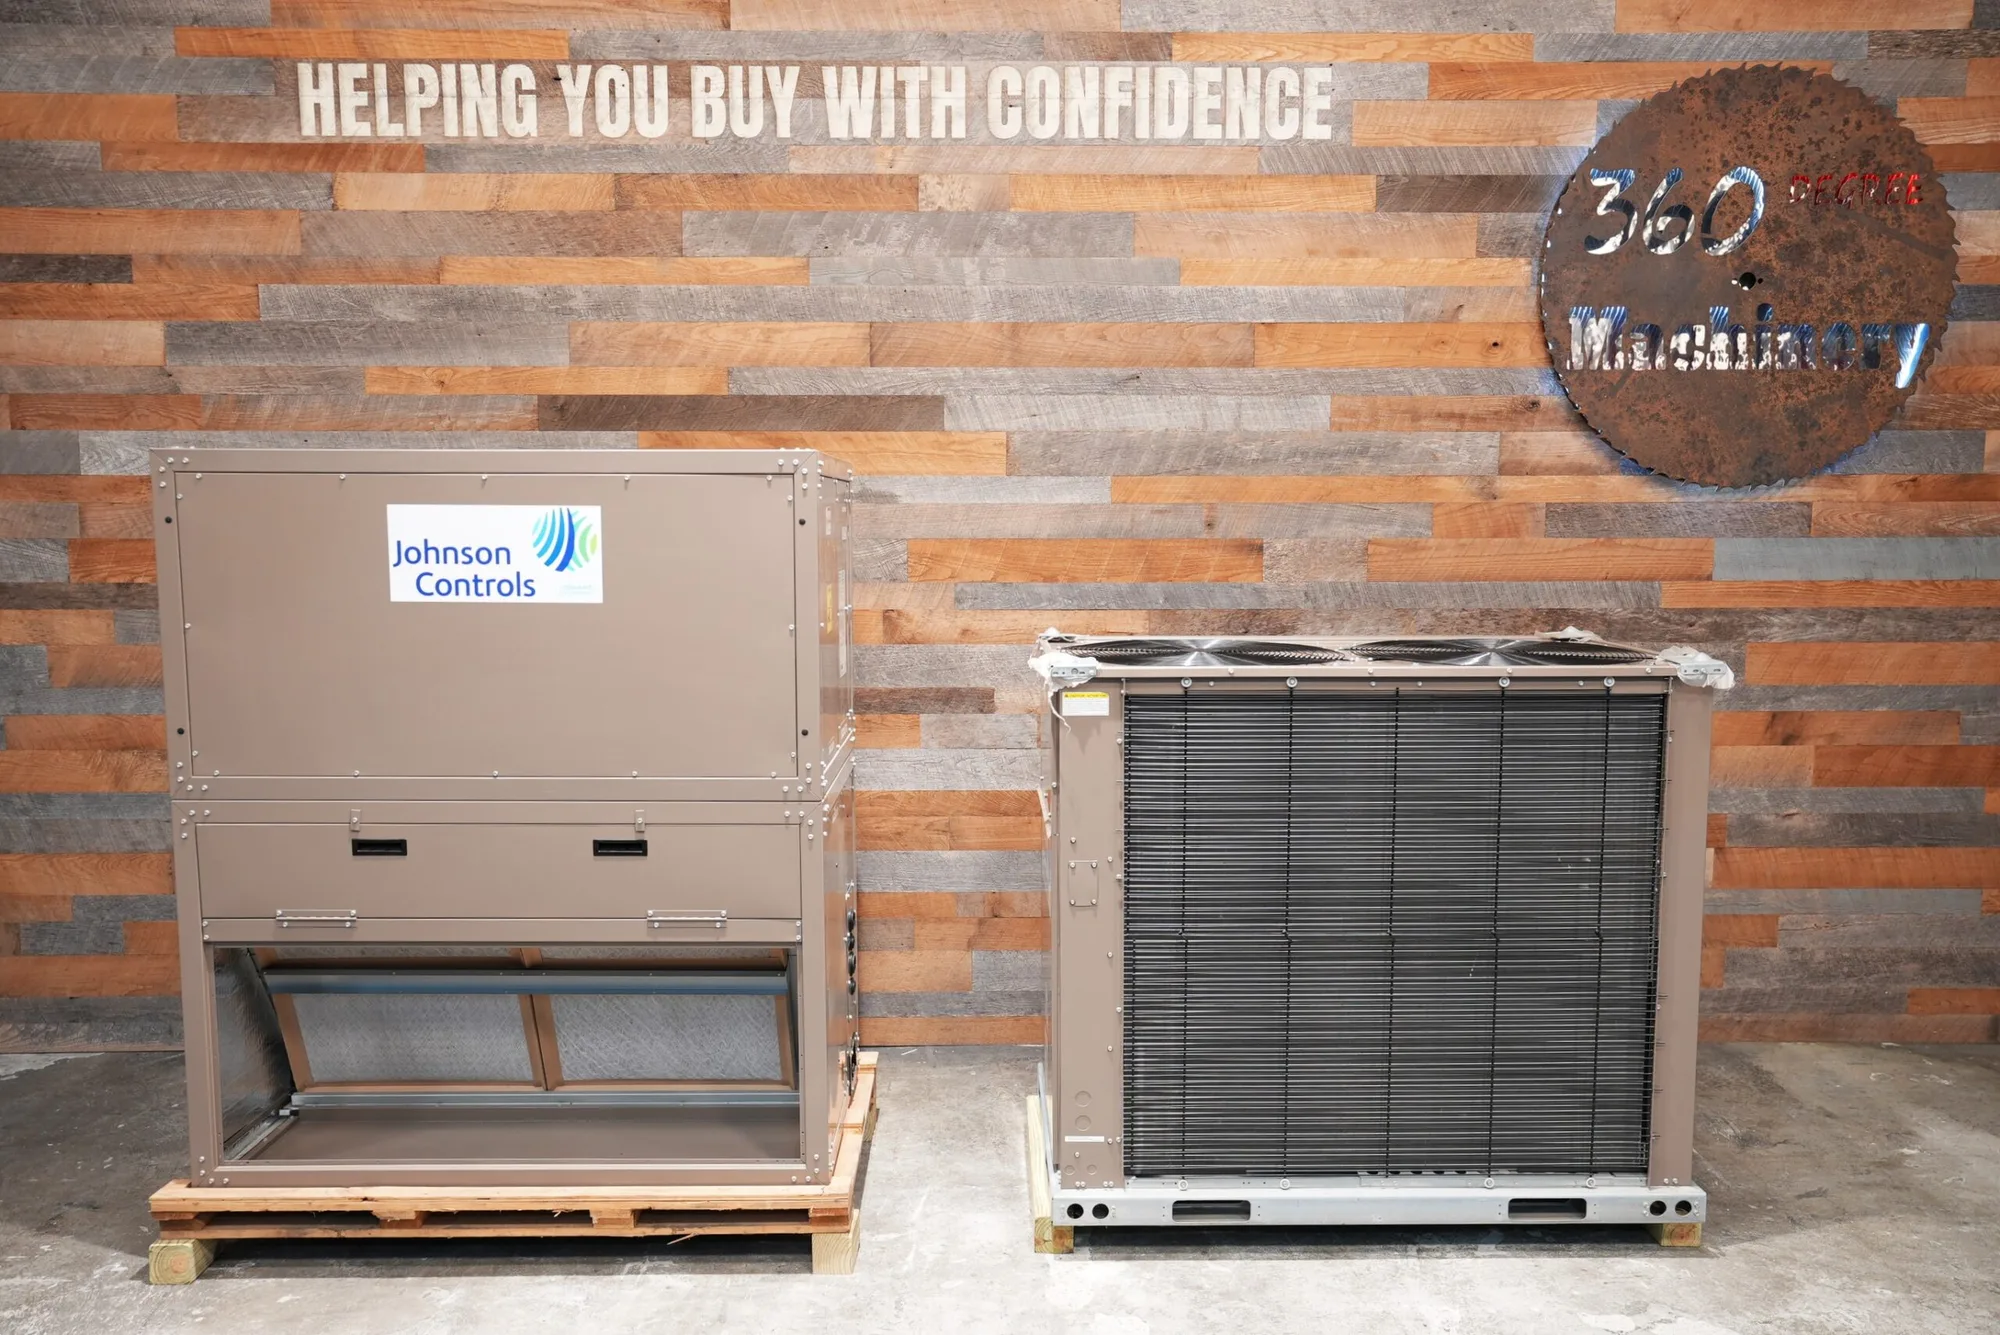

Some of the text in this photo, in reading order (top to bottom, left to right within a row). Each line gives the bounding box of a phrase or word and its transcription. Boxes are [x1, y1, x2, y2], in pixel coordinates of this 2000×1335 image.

[296, 62, 1334, 140] HELPING YOU BUY WITH CONFIDENCE
[1583, 165, 1923, 257] 360 DEGREE
[1566, 302, 1931, 390] Machinery
[392, 538, 511, 567] Johnson
[415, 570, 537, 598] Controls
